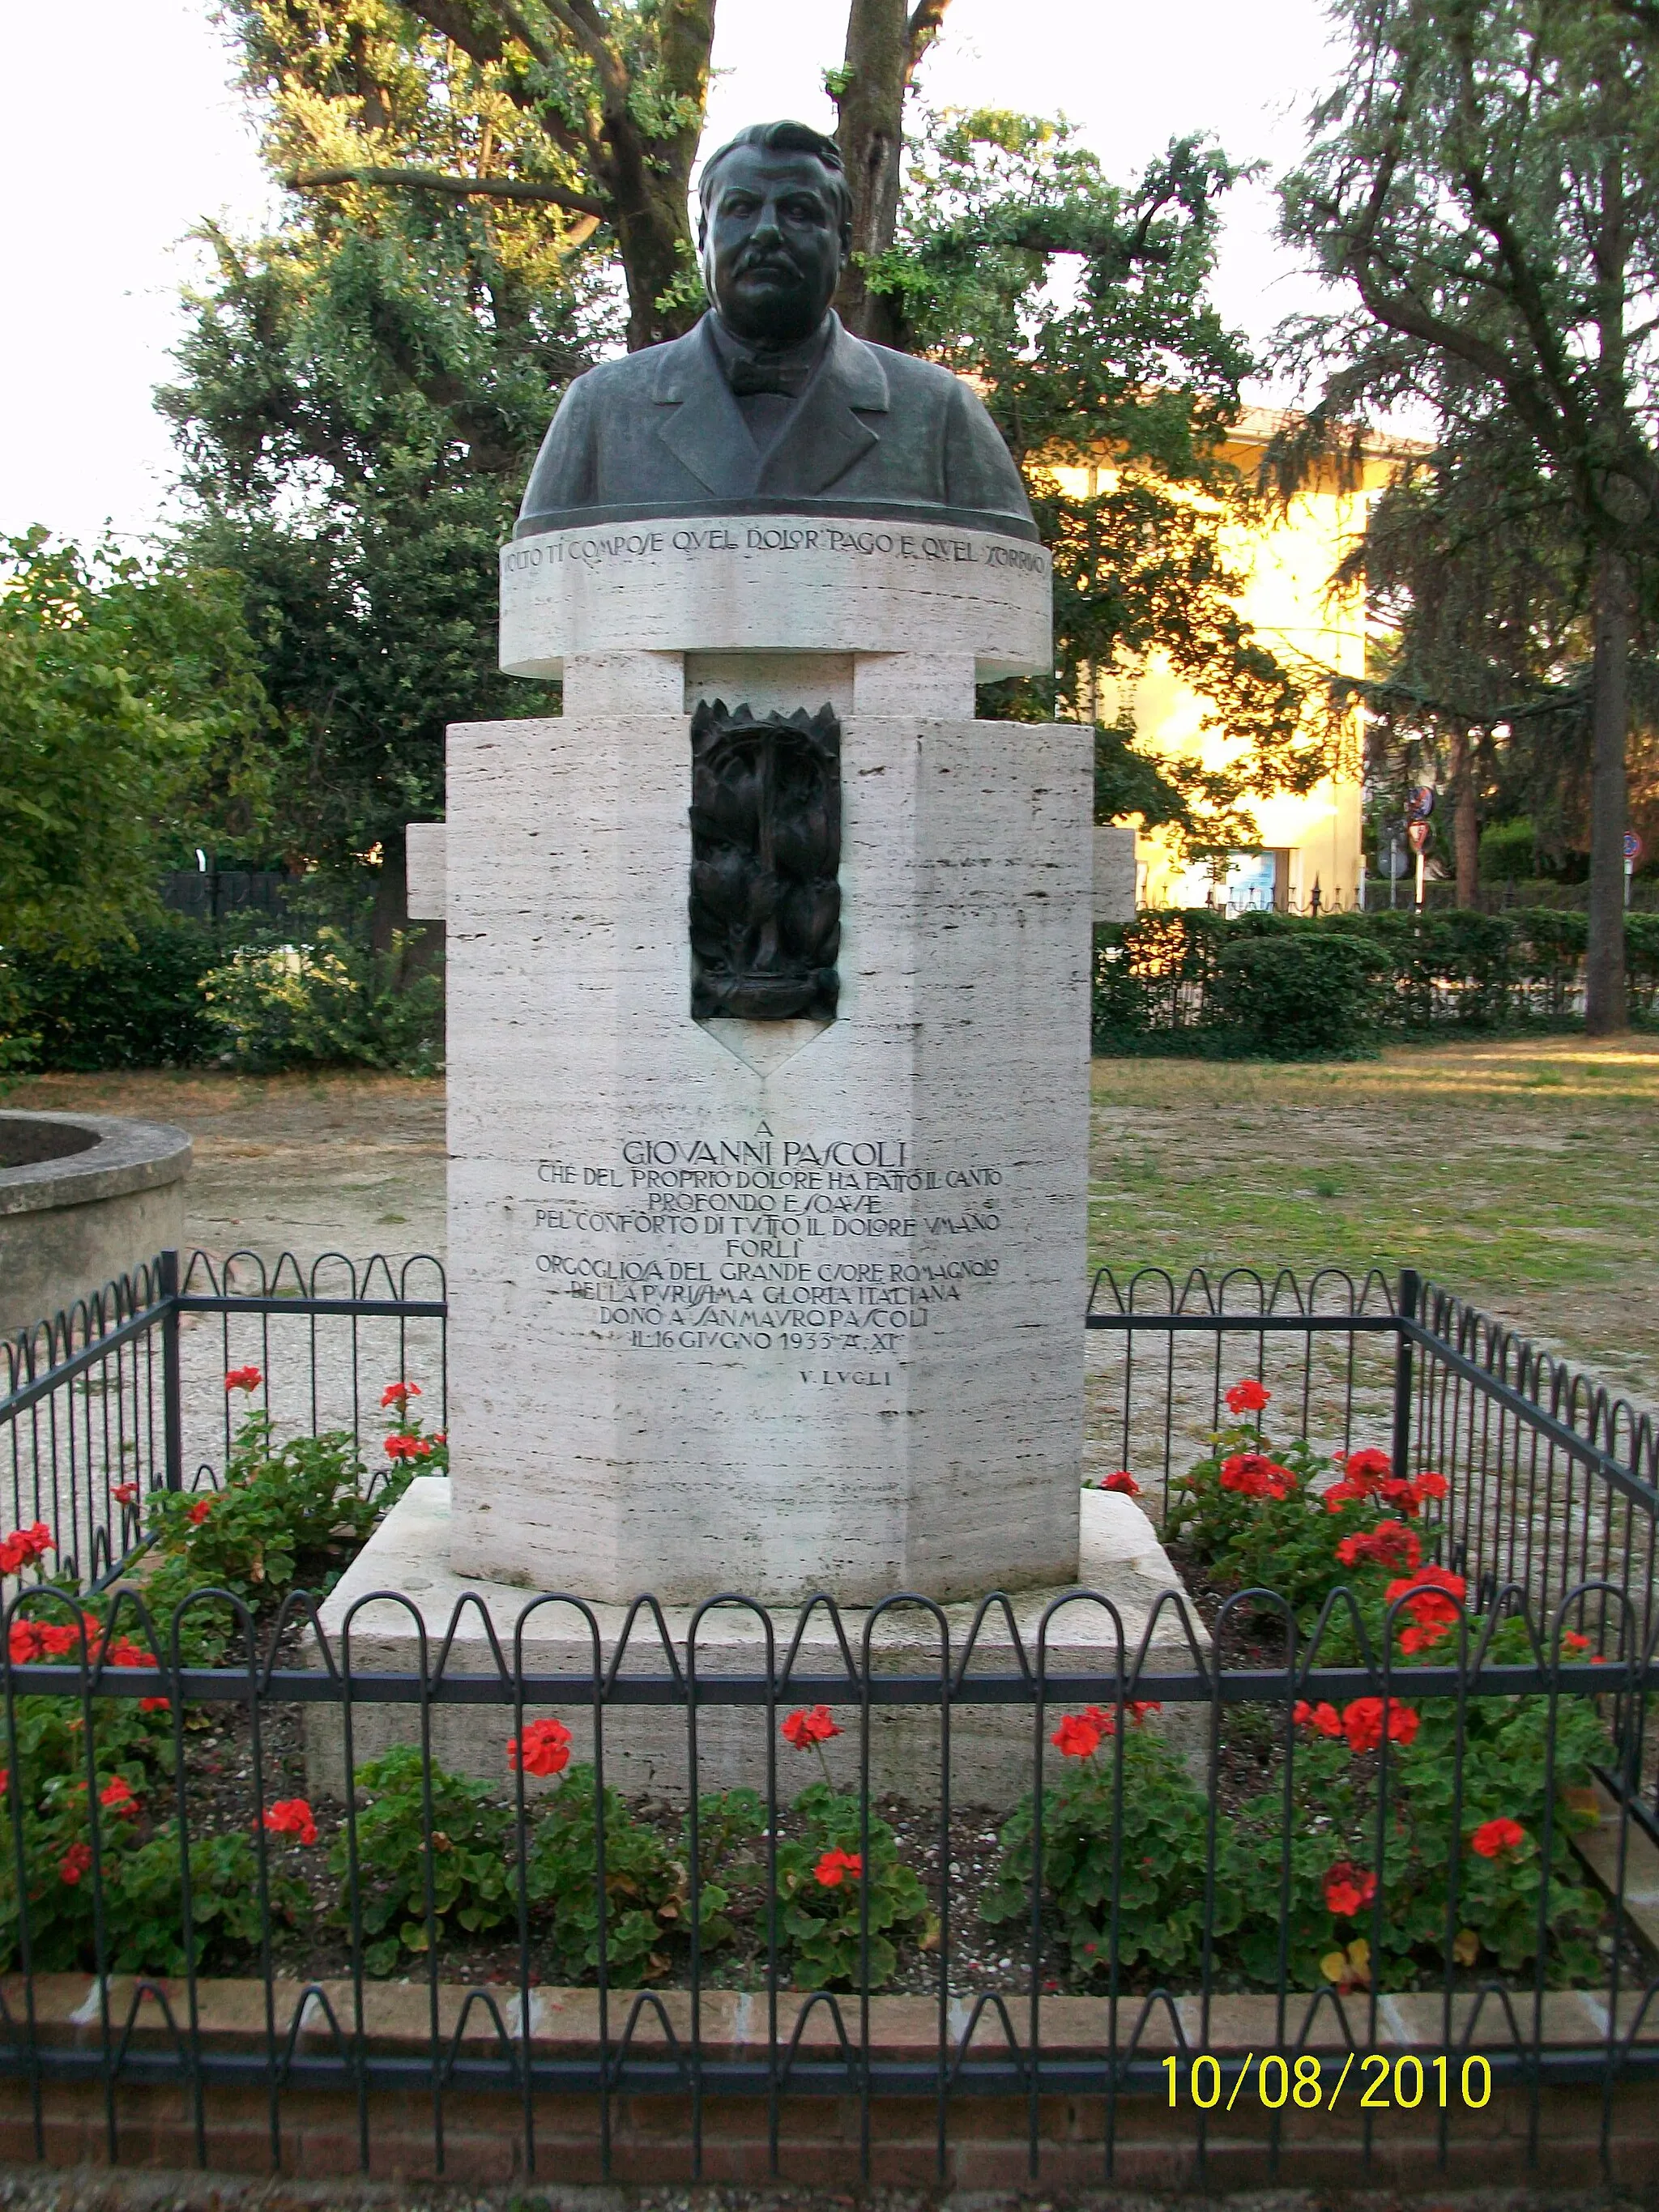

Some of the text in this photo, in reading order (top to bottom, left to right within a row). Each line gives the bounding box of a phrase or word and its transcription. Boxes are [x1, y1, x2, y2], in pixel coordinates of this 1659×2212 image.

[547, 543, 563, 563] TI
[673, 530, 738, 551] QVEL
[747, 529, 819, 551] DOLOR
[828, 530, 892, 554] PAGO
[900, 535, 915, 555] E
[923, 537, 978, 560] QVEL
[754, 1121, 774, 1137] A
[623, 1140, 906, 1166] GIOVANNI PASCOLI
[537, 1165, 1002, 1192] CHE DEL PROPRIO DOLORE HA FATTO IL CANTO
[647, 1192, 776, 1212] PROFONDO
[783, 1194, 797, 1212] E
[535, 1209, 570, 1229] PEL
[576, 1213, 698, 1234] CONFORTO
[704, 1217, 724, 1234] DI
[732, 1214, 800, 1238] TVTTO
[807, 1217, 825, 1236] IL
[832, 1216, 916, 1237] DOLORE
[726, 1238, 804, 1258] FORLÌ
[670, 1263, 712, 1281] DEL
[719, 1263, 812, 1281] GRANDE
[889, 1259, 1000, 1281] ROMAGNOLO
[570, 1281, 638, 1302] DELLA
[763, 1286, 852, 1305] GLORIA
[859, 1285, 962, 1305] ITALIANA
[600, 1306, 663, 1324] DONO
[667, 1310, 685, 1325] A
[631, 1331, 653, 1347] IL
[655, 1331, 673, 1348] 16
[678, 1332, 771, 1349] GIVGNO
[822, 1370, 891, 1386] LVGLI
